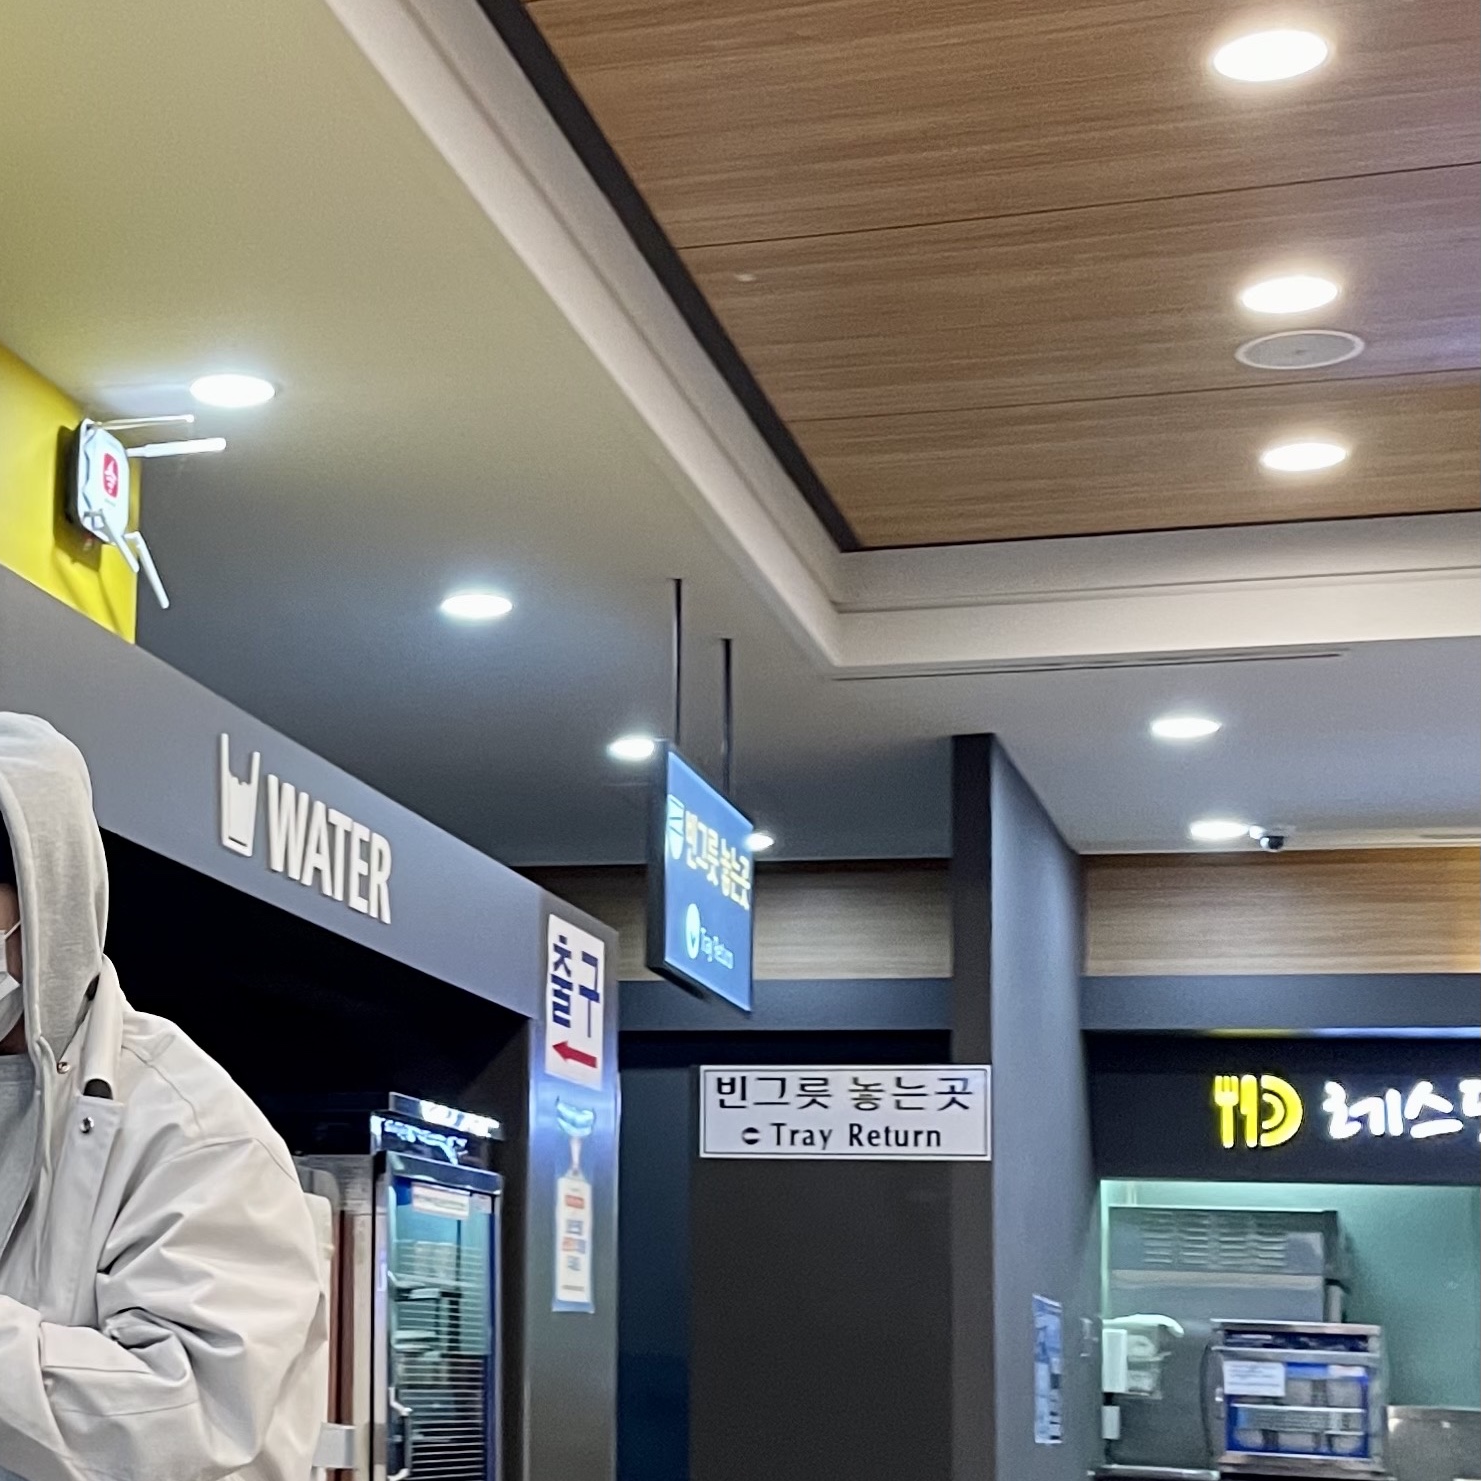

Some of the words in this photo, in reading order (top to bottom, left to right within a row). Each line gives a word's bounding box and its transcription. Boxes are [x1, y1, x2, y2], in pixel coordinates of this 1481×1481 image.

[267, 773, 392, 925] WATER
[551, 934, 601, 1039] 출구
[716, 1076, 833, 1110] 빈그릇
[848, 1076, 974, 1112] 놓는곳
[771, 1123, 833, 1150] Tray
[849, 1123, 941, 1148] Return
